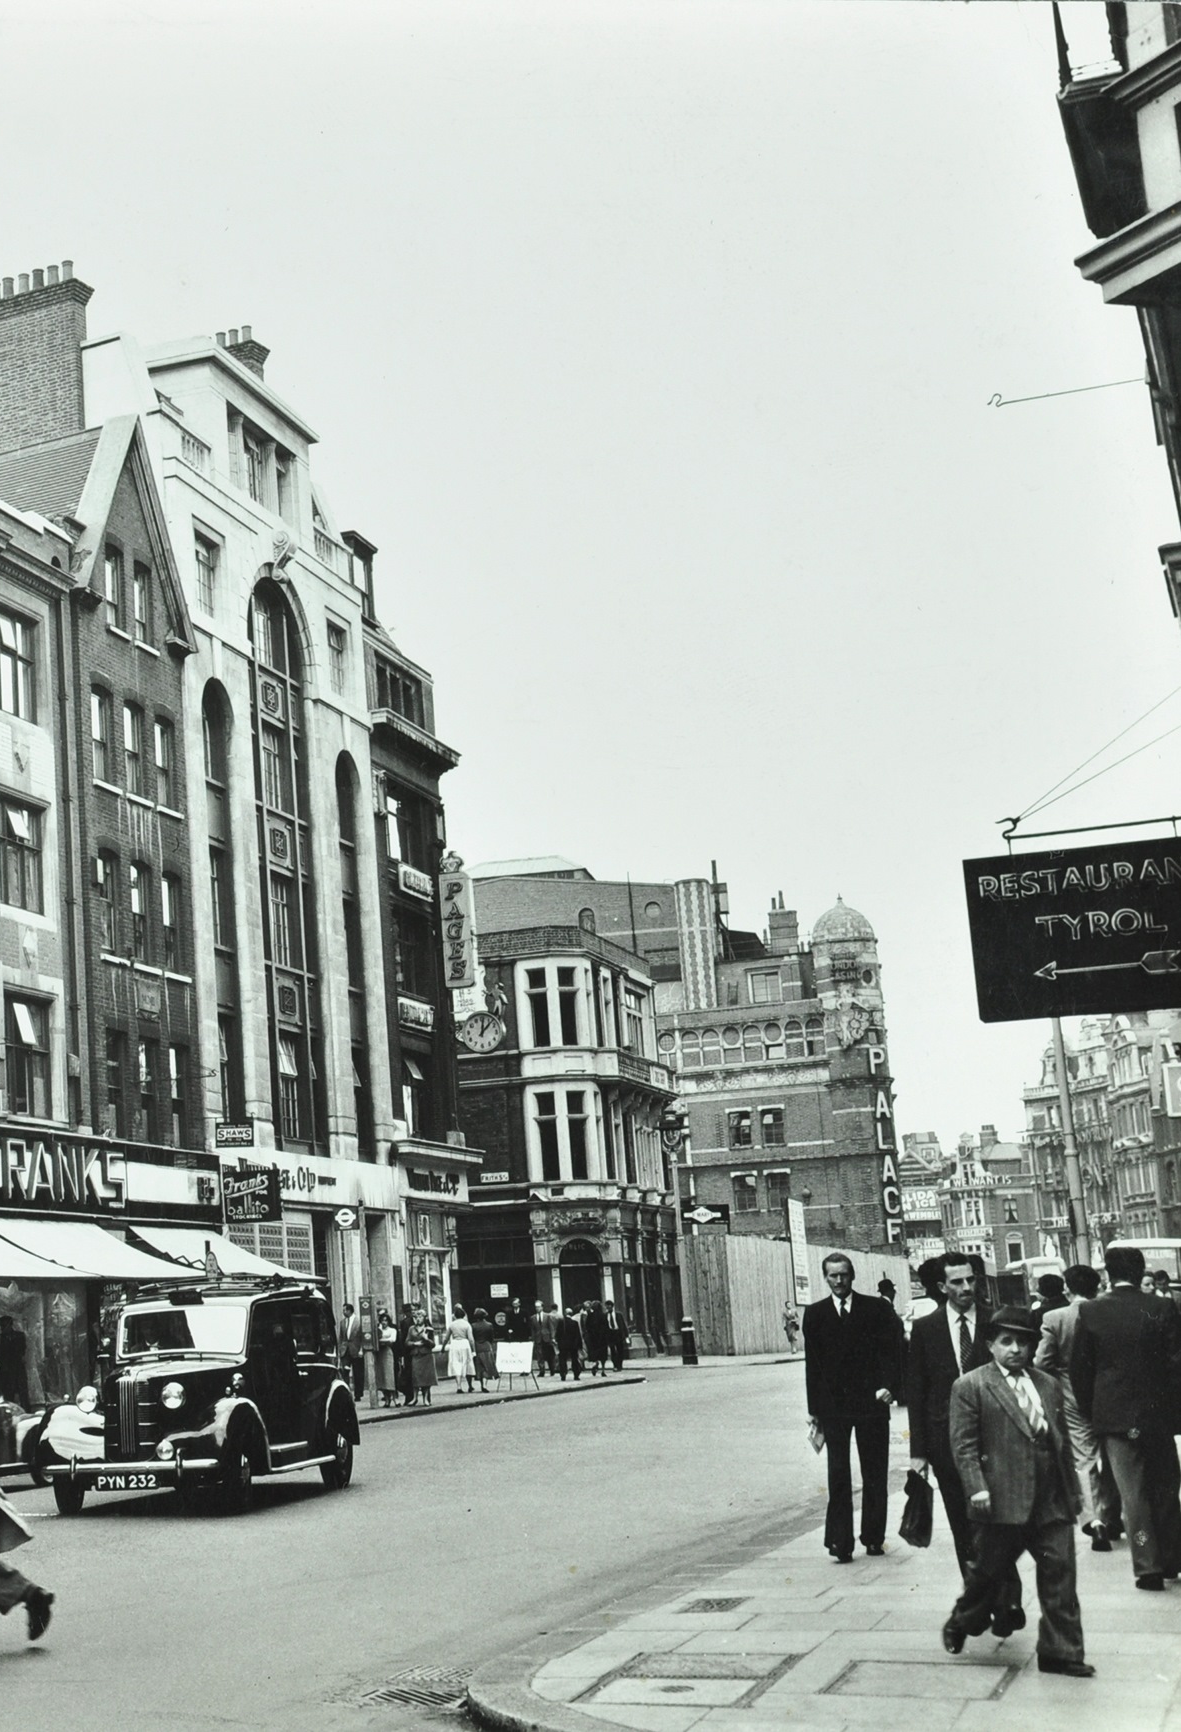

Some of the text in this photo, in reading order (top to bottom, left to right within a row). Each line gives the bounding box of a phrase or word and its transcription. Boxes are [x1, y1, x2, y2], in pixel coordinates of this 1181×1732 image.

[978, 857, 1181, 901] RESTAURAN
[445, 881, 467, 981] PAGES
[1035, 908, 1168, 940] TYROL
[218, 1129, 251, 1139] SHAWS
[223, 1173, 269, 1196] Franks
[227, 1194, 269, 1215] ballito
[97, 1474, 156, 1489] PYN 232
